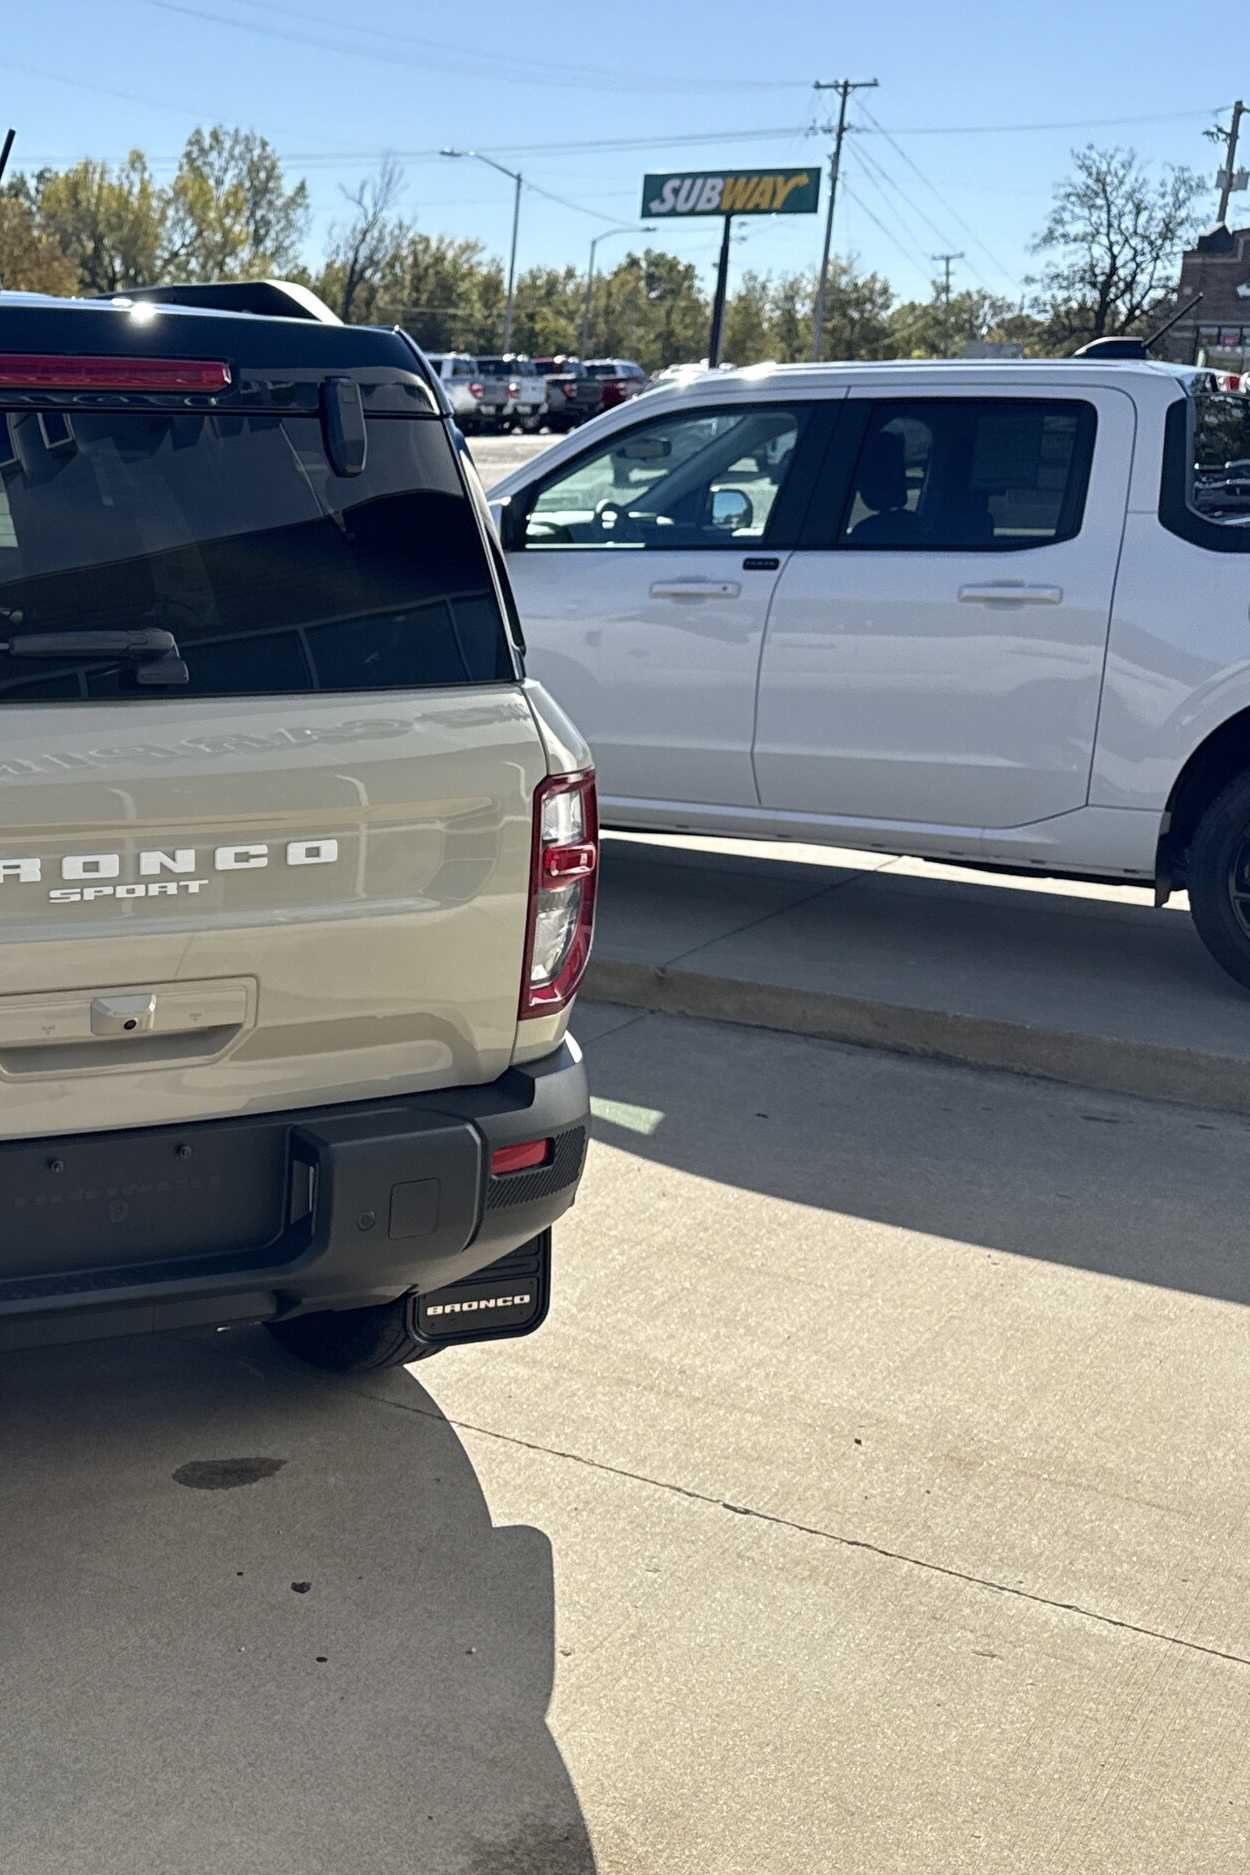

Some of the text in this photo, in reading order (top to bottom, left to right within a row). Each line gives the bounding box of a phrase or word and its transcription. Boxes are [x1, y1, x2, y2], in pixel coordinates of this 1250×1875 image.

[649, 173, 809, 213] SUBWAY
[48, 879, 209, 904] SPORT
[427, 1294, 530, 1316] BRONCO
